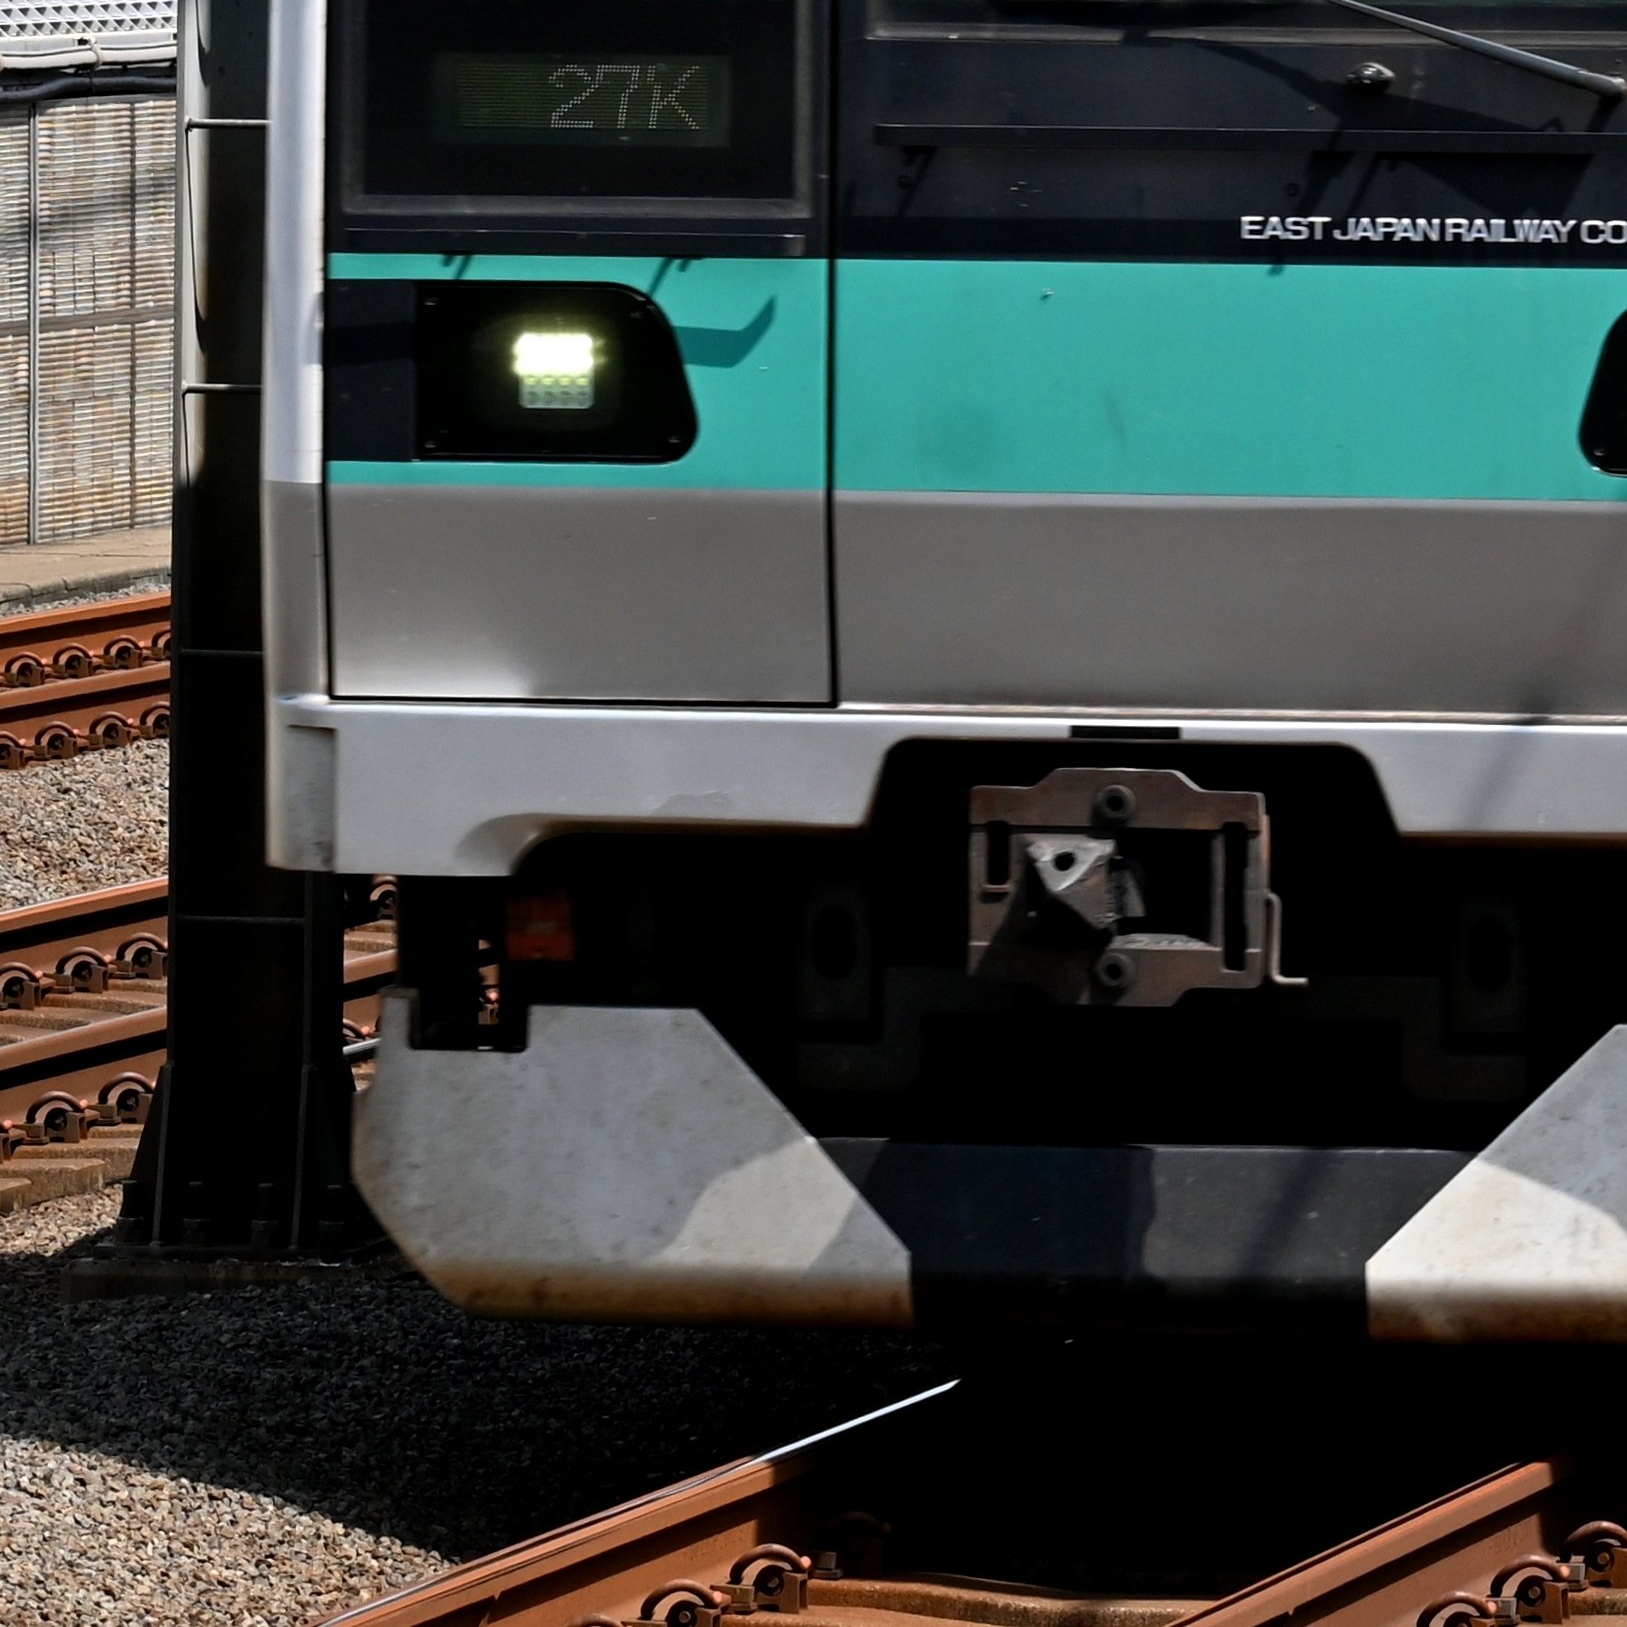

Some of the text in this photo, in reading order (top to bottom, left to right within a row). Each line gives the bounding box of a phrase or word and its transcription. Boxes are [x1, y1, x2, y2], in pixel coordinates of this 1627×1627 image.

[549, 64, 700, 129] 27K
[1239, 215, 1332, 241] EAST
[1332, 216, 1441, 242] JAPAN
[1444, 217, 1577, 244] RAILWAY
